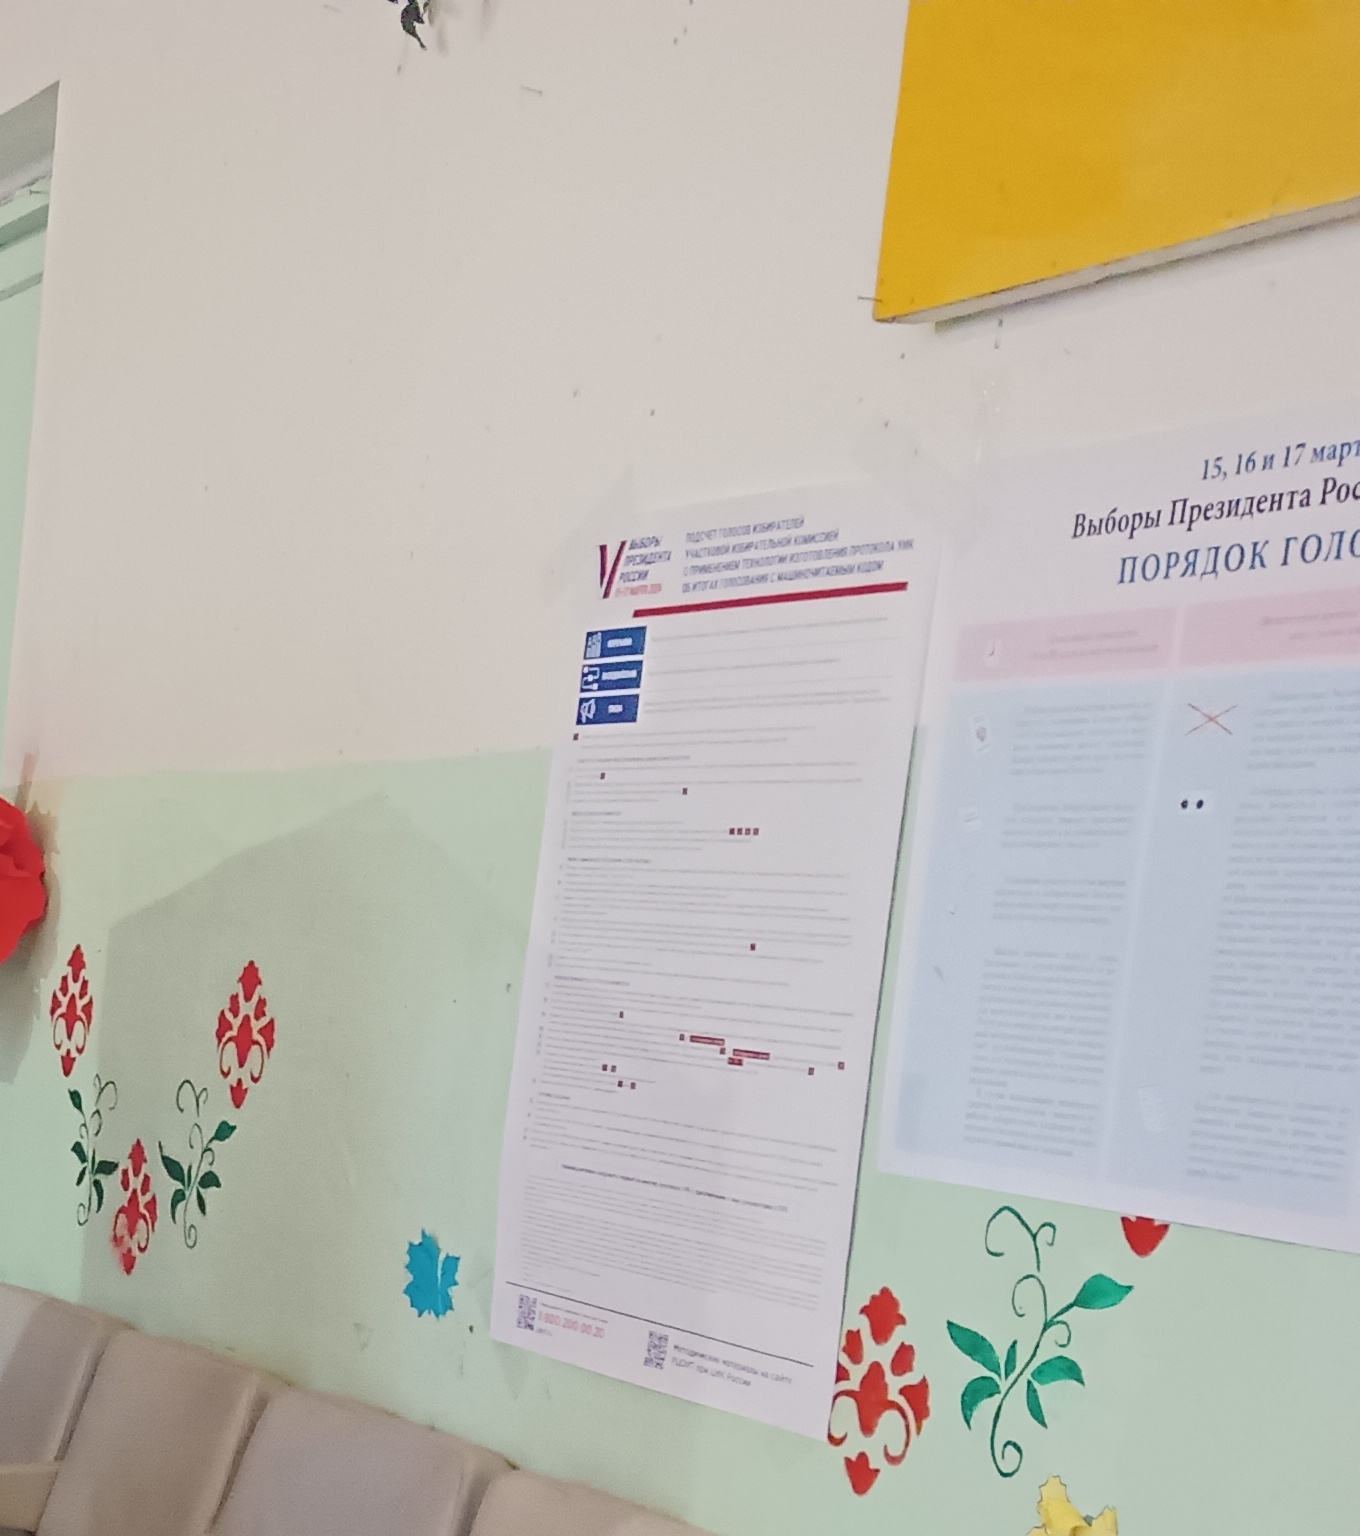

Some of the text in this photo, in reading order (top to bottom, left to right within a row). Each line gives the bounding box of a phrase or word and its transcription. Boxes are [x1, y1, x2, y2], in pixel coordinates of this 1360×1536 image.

[1202, 457, 1227, 481] 15,
[1235, 451, 1257, 475] 16
[1261, 453, 1275, 471] и
[1282, 442, 1307, 468] 17
[1071, 507, 1162, 540] Выборы
[1167, 488, 1312, 532] Президента
[1117, 539, 1270, 585] ПОРЯДОК
